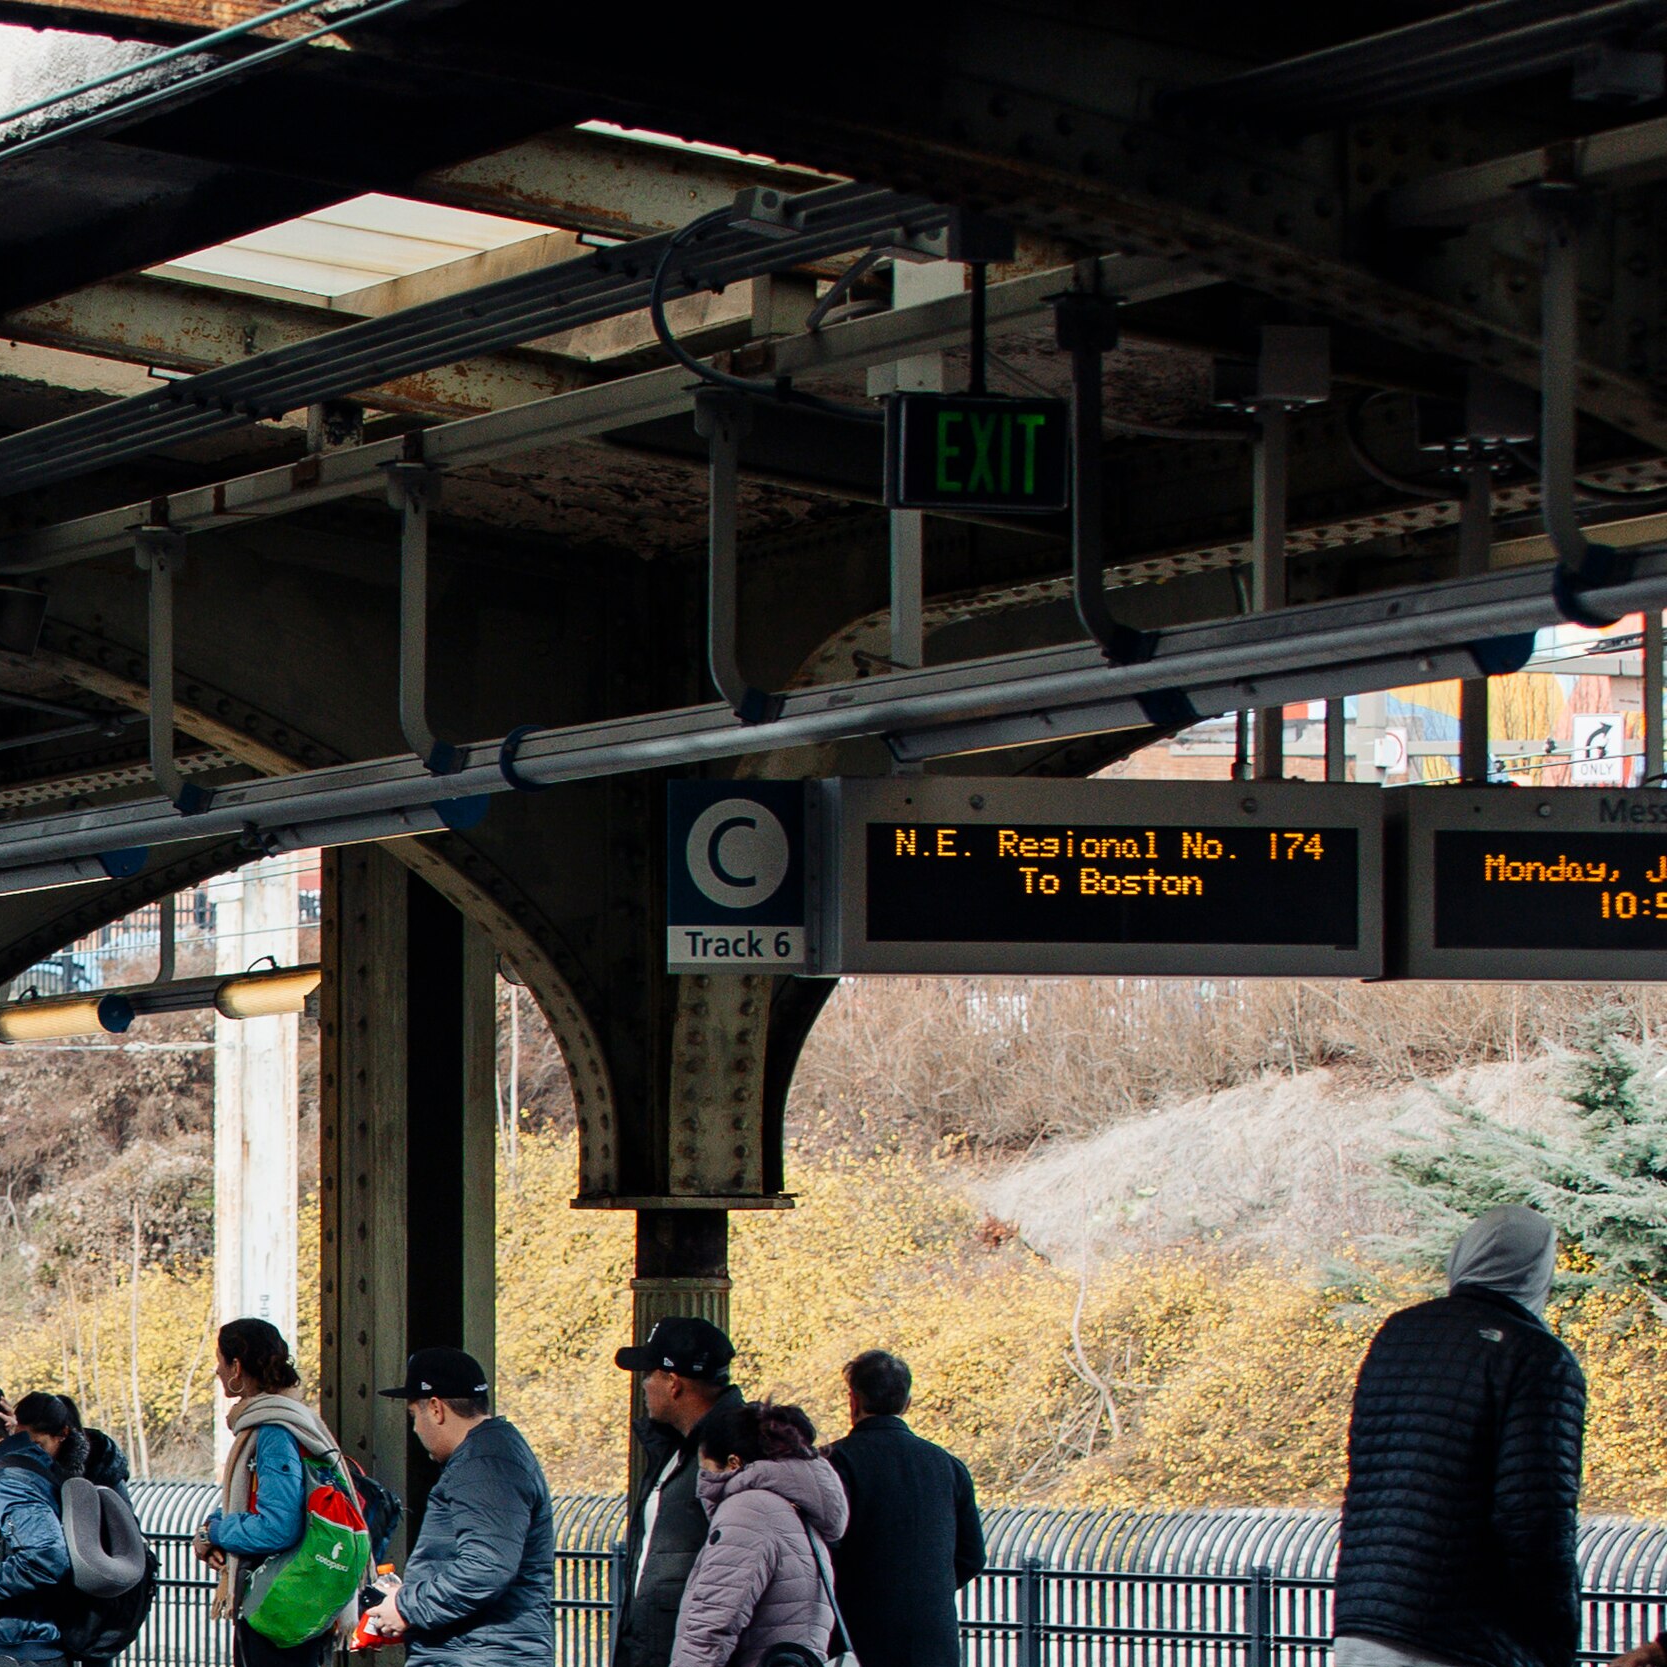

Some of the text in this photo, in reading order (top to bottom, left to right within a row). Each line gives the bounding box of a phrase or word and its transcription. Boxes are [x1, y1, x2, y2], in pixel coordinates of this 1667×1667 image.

[935, 410, 1047, 496] EXIT
[1580, 762, 1614, 776] ONLY
[707, 816, 757, 888] C
[896, 829, 1325, 860] N.E. Regional No. 174
[1019, 867, 1203, 896] To Boston
[1484, 854, 1620, 883] Monday,
[684, 929, 792, 958] Track 6
